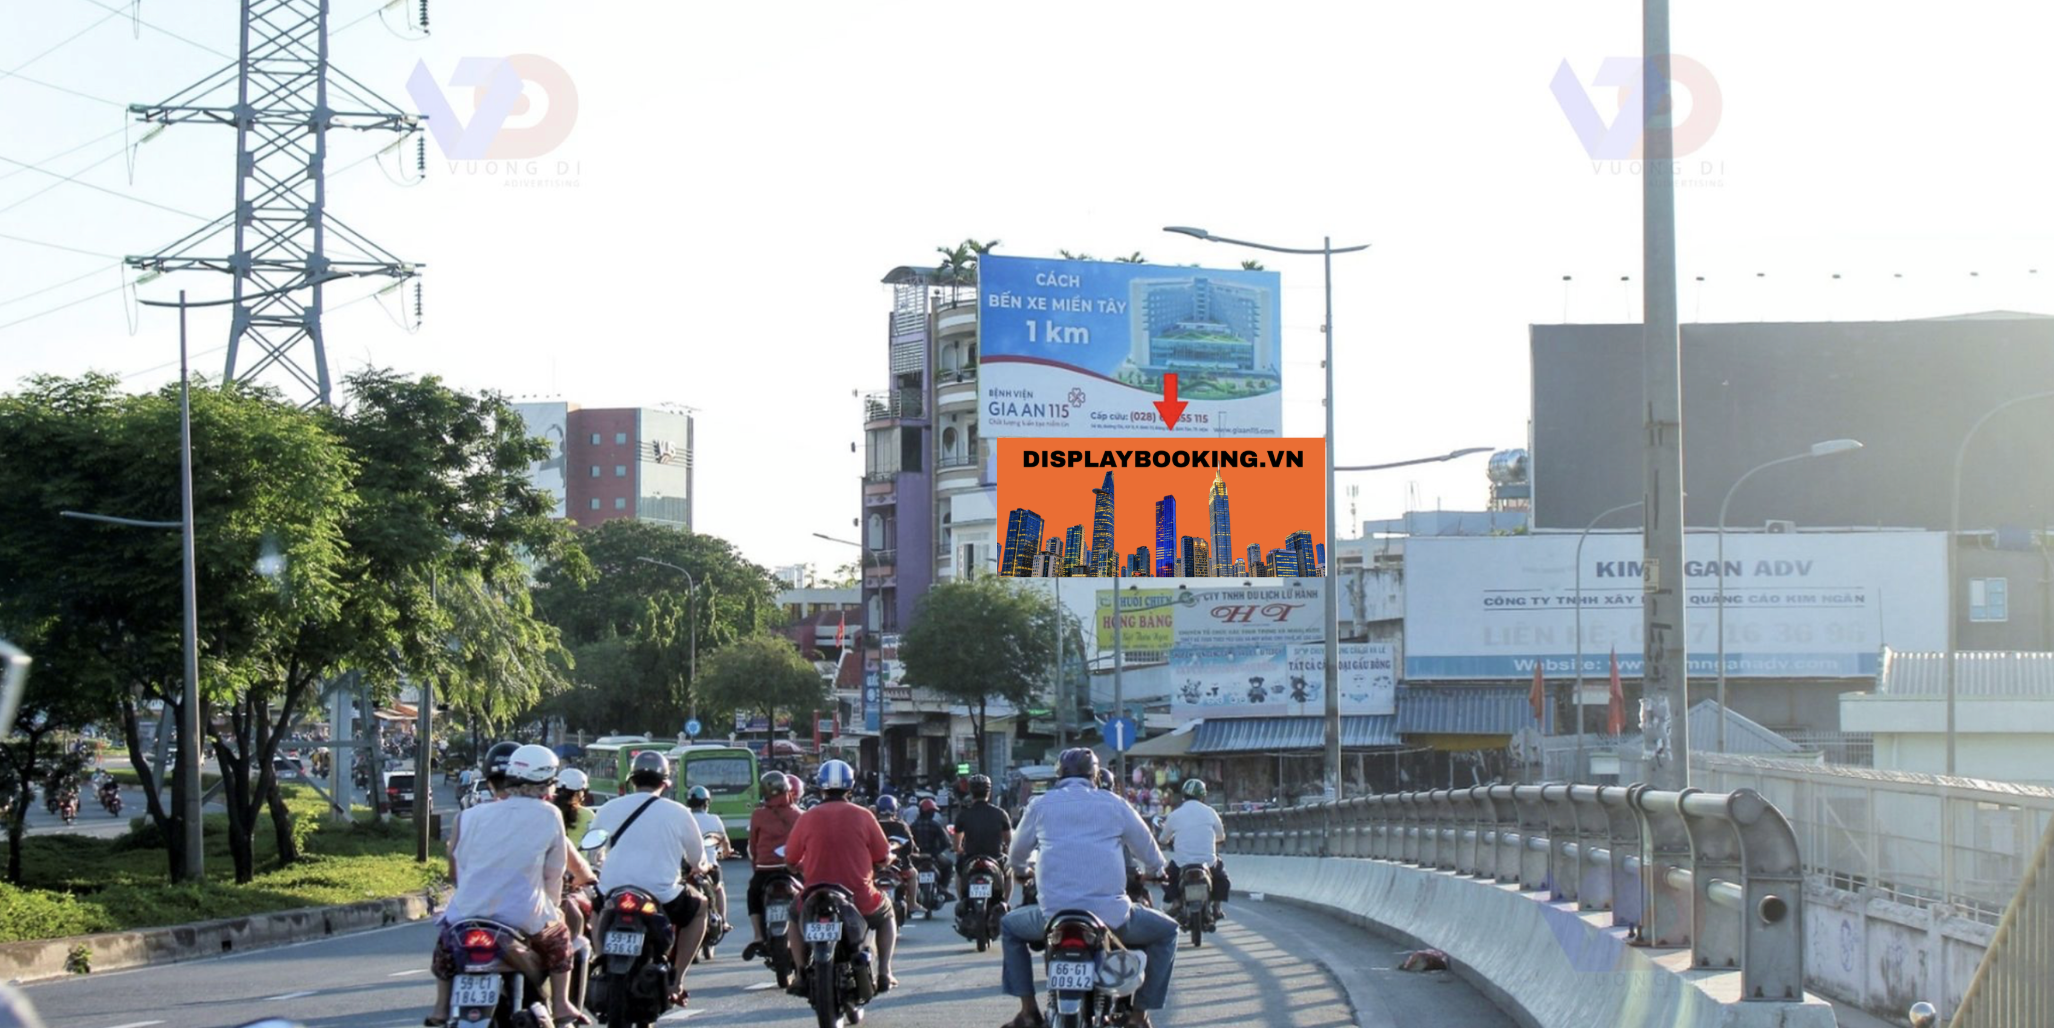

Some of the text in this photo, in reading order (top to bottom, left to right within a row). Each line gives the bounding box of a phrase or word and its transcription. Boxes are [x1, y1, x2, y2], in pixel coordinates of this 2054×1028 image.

[1036, 271, 1080, 288] CÁCH
[989, 290, 1022, 309] BẾN
[1027, 297, 1047, 310] XE
[1097, 298, 1127, 314] TÂY
[1026, 320, 1089, 344] 1 km
[989, 388, 1033, 400] BỆNH VIỆN
[989, 402, 1069, 418] GIA AN 115
[1130, 411, 1156, 423] (028)
[1194, 414, 1208, 423] 115
[1684, 560, 1742, 577] GAN
[1754, 560, 1814, 577] ADV
[1222, 591, 1244, 600] TNHH
[1247, 591, 1259, 600] DU
[1483, 596, 1526, 606] CÔNG
[1531, 596, 1551, 605] TY
[1556, 596, 1598, 605] TNHH
[1604, 594, 1635, 604] XÂY
[1786, 596, 1816, 604] KIM
[1056, 963, 1087, 975] 66-G1
[460, 976, 491, 990] 59-C1
